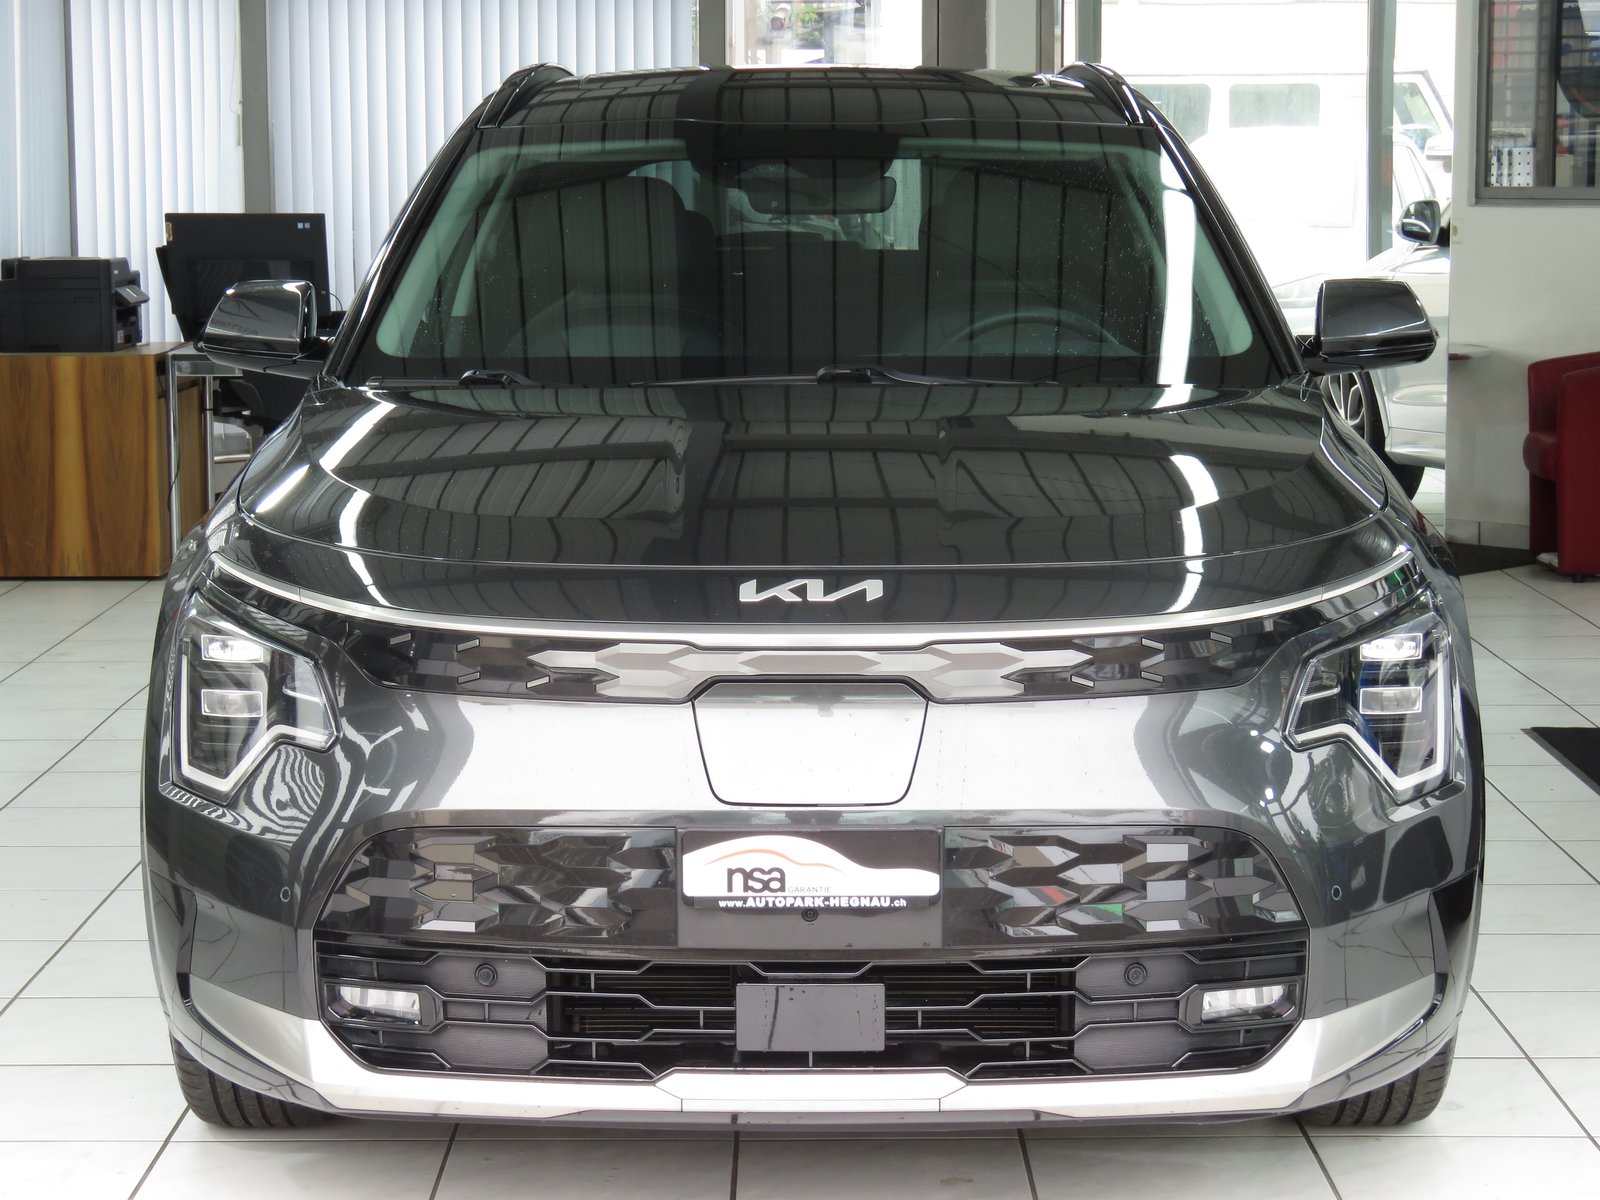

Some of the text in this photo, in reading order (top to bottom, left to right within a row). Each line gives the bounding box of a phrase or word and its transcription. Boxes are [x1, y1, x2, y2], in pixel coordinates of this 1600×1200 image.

[739, 579, 883, 602] KIA
[727, 867, 786, 893] nsa
[718, 896, 907, 908] www.AUTOPARK-HEGNAU.ch
